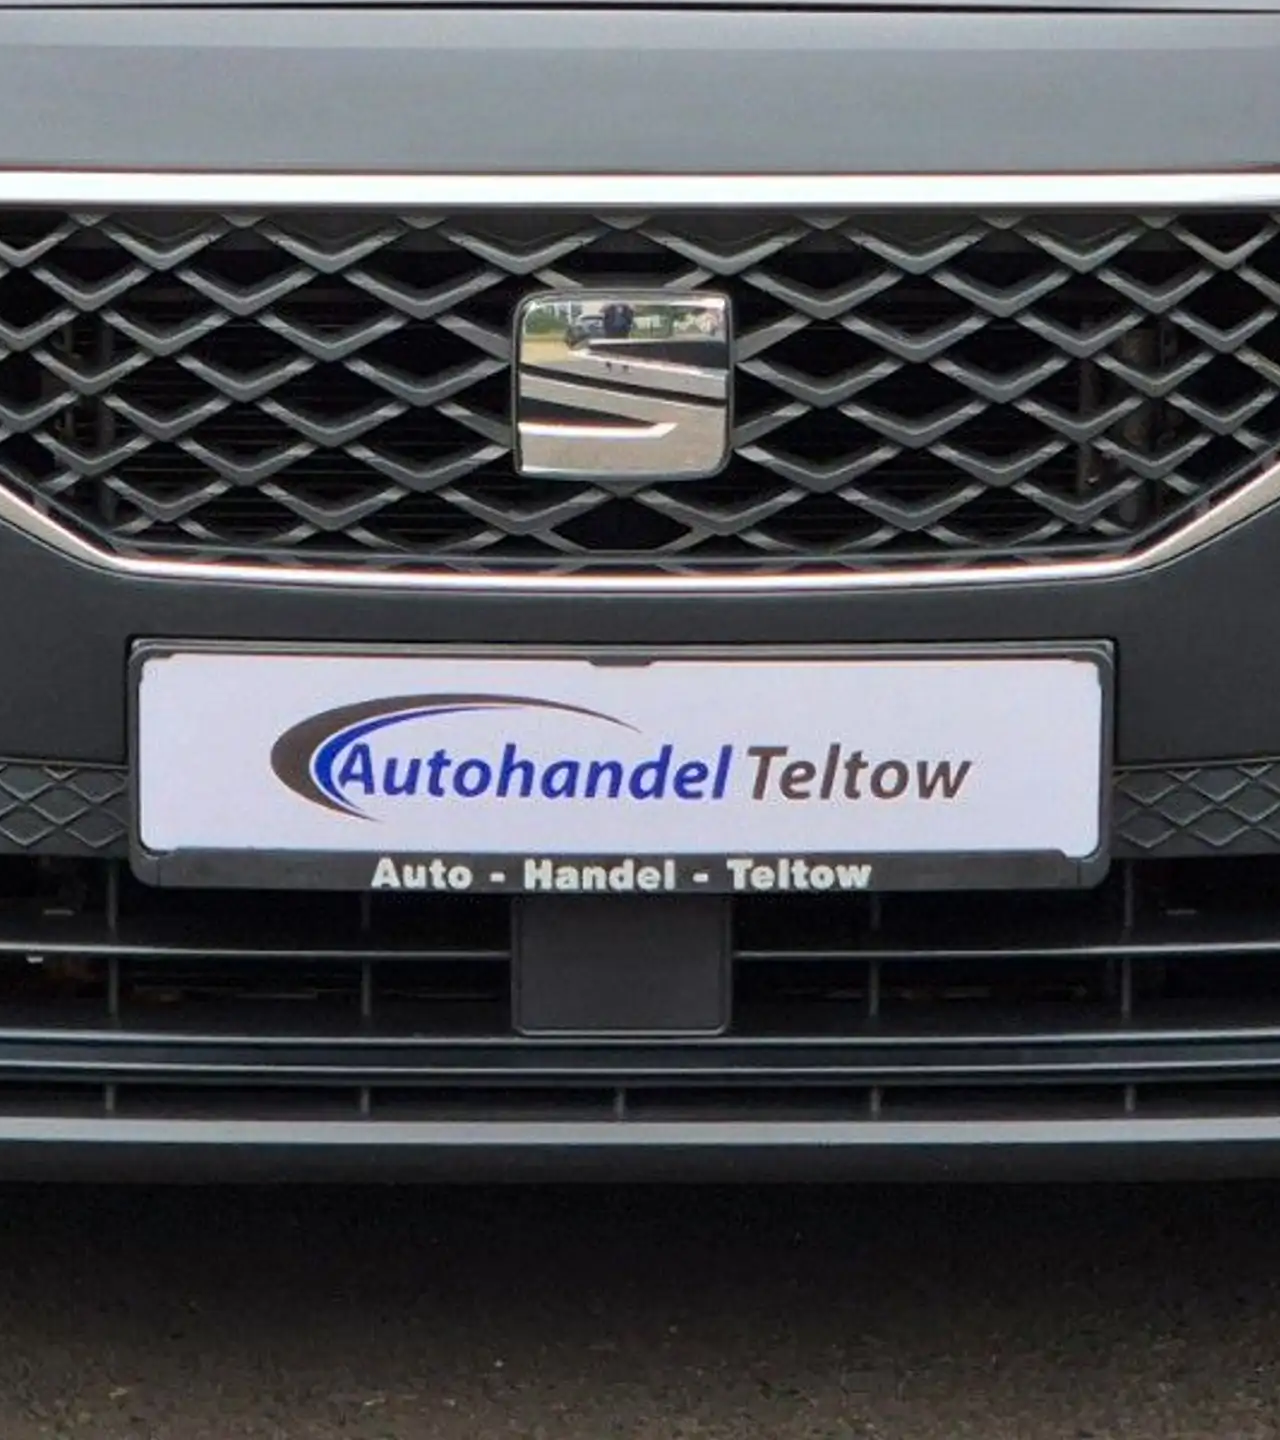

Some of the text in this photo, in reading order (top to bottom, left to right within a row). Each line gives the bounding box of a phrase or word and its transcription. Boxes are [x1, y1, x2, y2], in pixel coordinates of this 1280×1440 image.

[337, 742, 973, 800] Autohandel Teltow
[370, 857, 473, 890] Auto
[523, 858, 676, 891] Handel
[726, 857, 873, 891] Teltow
